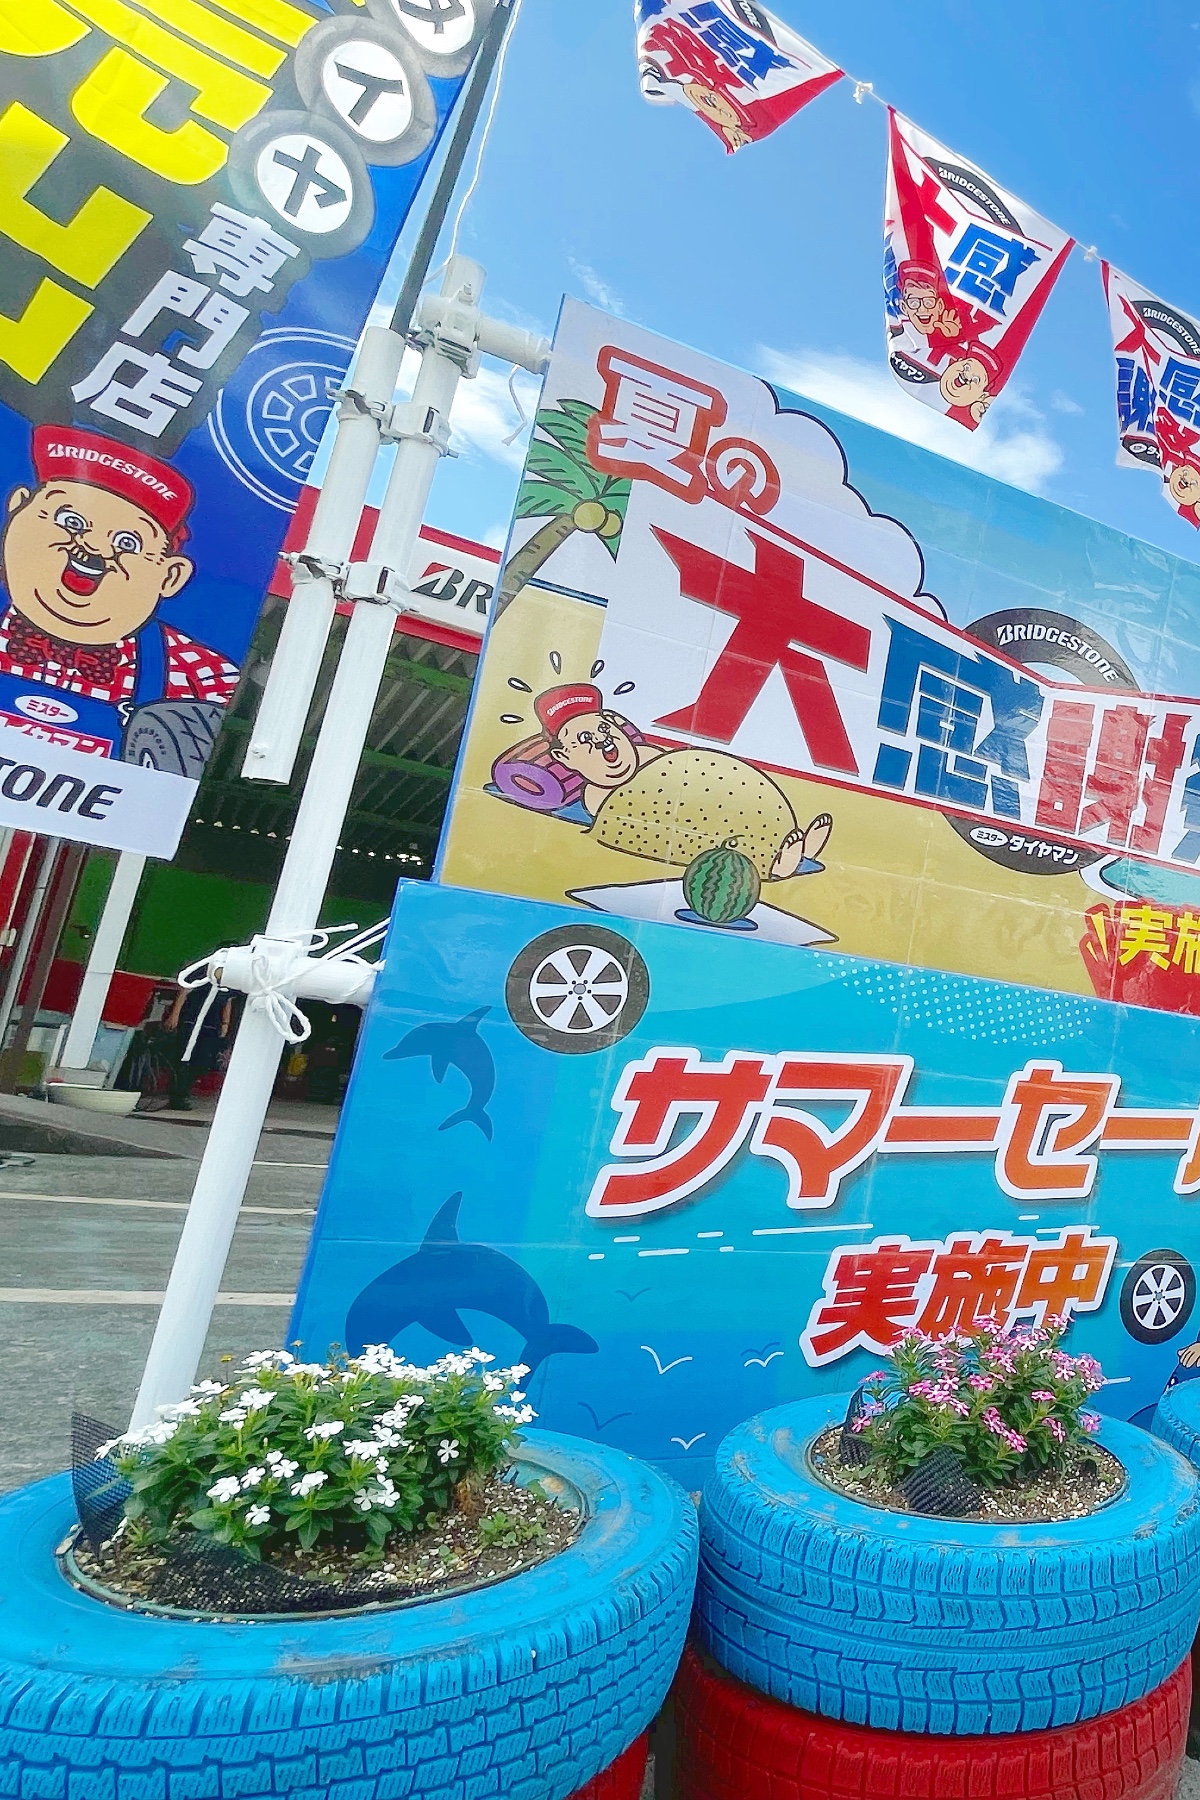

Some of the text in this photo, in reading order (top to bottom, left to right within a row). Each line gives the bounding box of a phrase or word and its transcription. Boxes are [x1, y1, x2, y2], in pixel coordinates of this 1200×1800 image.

[938, 167, 1011, 225] BRIDGESTONE
[590, 348, 780, 513] 夏の
[47, 443, 178, 501] BRIDGESTONE
[997, 624, 1119, 682] BRIDGESTONE
[26, 698, 69, 717] ミスター
[1009, 835, 1079, 865] タイヤマン
[802, 1226, 1117, 1368] 実施中
